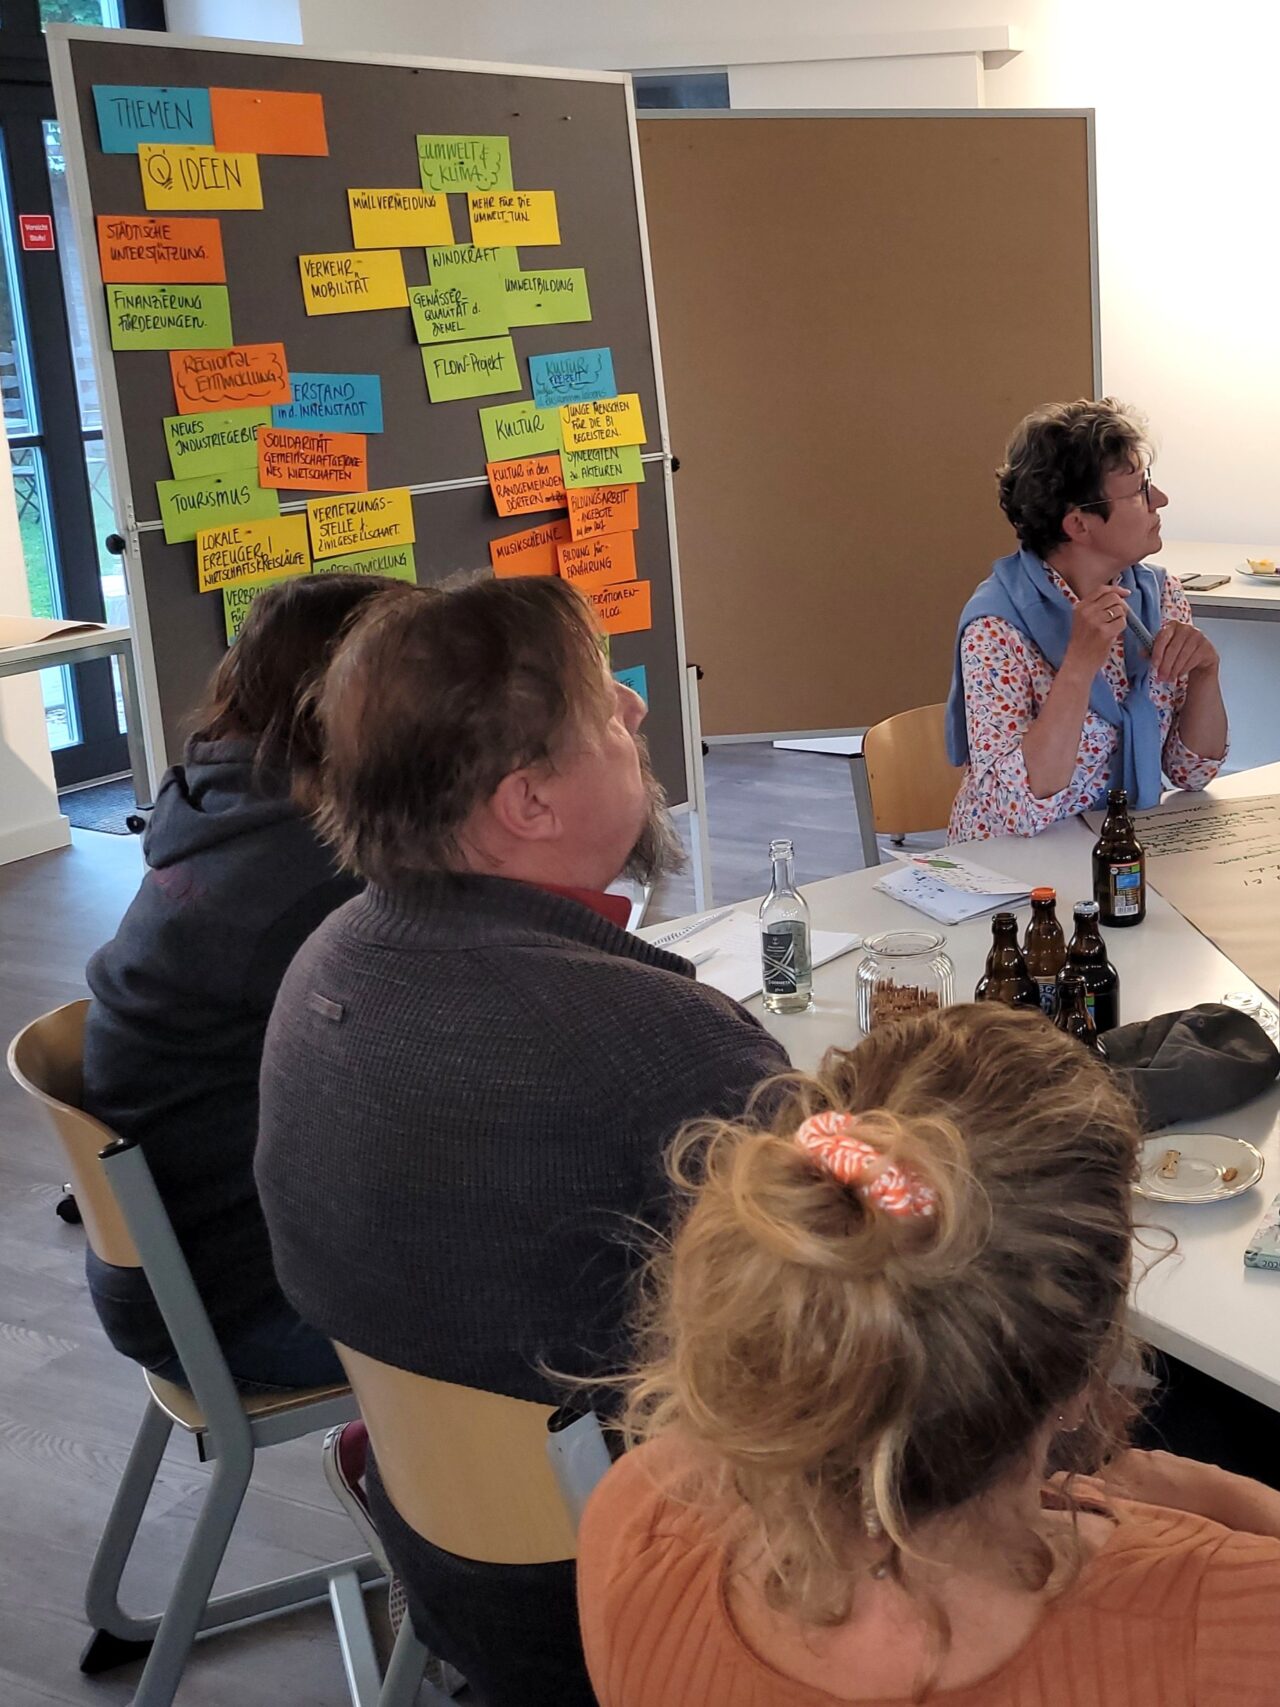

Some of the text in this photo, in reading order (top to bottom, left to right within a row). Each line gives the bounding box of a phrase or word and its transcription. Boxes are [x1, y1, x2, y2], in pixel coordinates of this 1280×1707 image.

[110, 97, 194, 130] THEMEN
[425, 141, 480, 161] UMWELT
[179, 157, 242, 192] IDEEN
[472, 196, 496, 210] MEHR
[432, 246, 501, 267] WINDKRAFT
[113, 290, 203, 310] FINANZIERUNG
[290, 382, 355, 405] ERSTAND
[562, 403, 590, 424] JUNGE
[171, 420, 205, 438] NEUES
[495, 414, 545, 441] KULTUR
[492, 464, 524, 482] KULTUR
[319, 518, 354, 537] STELLE
[202, 527, 242, 551] LOKALE
